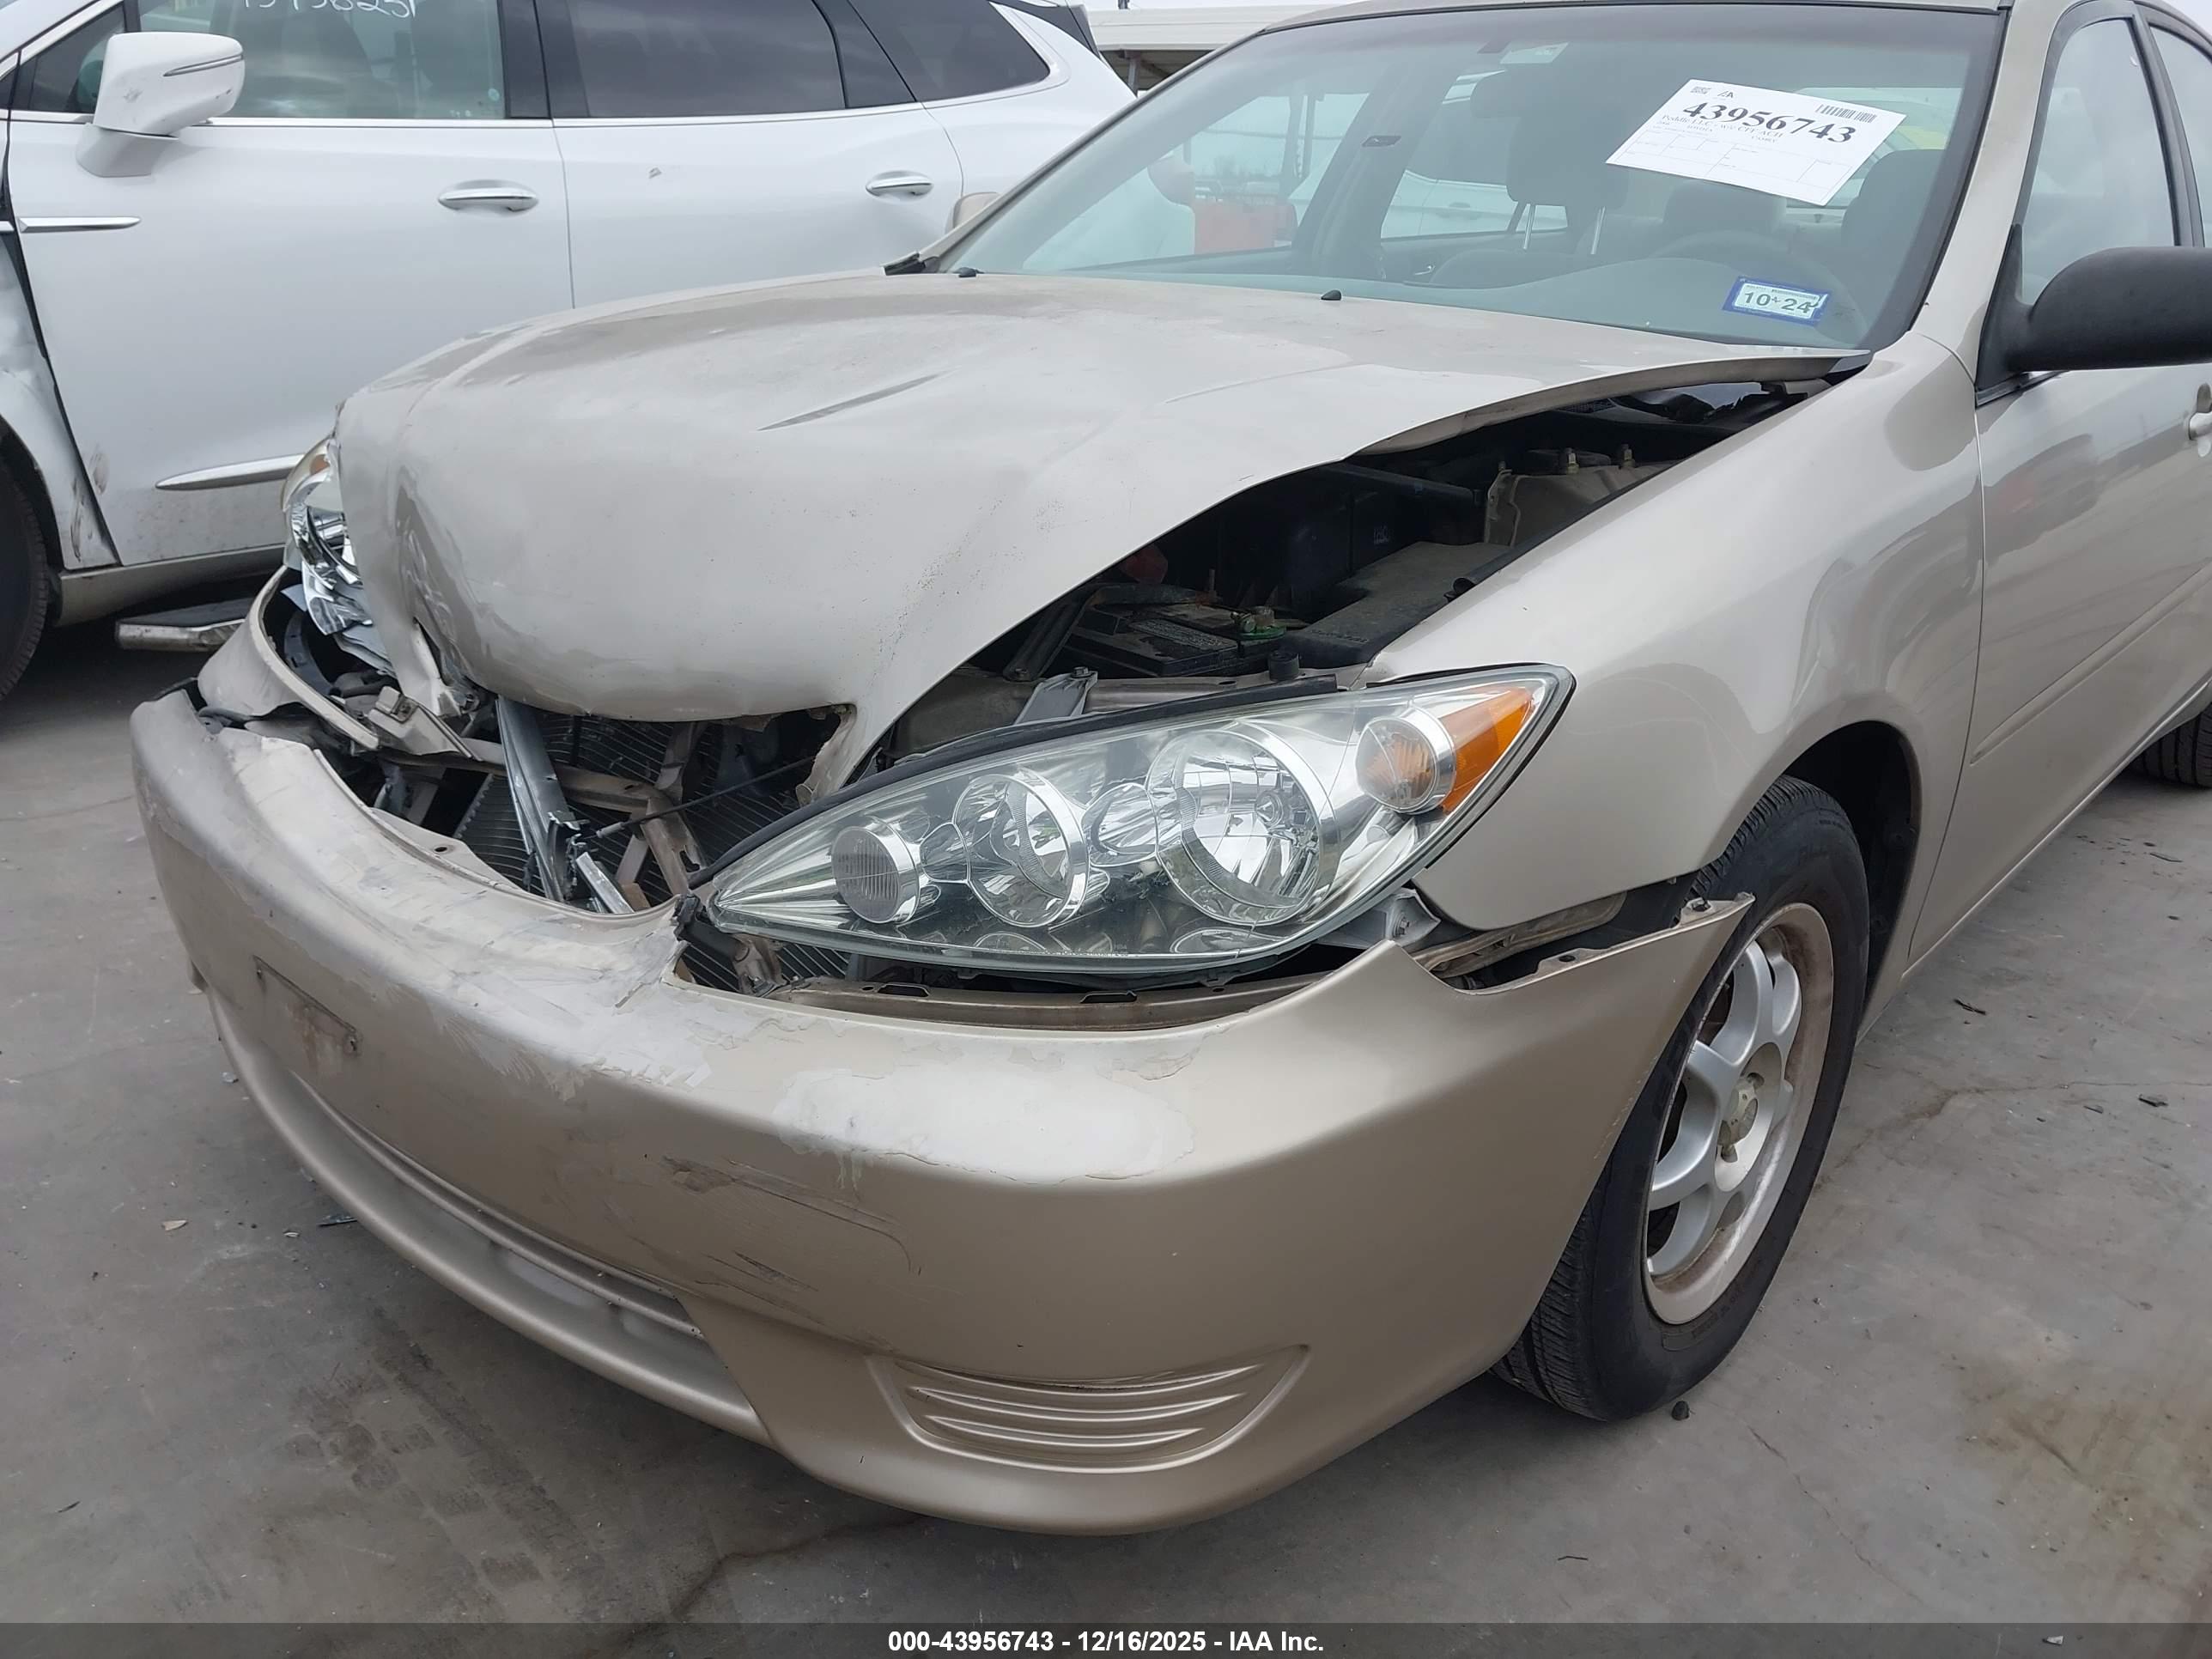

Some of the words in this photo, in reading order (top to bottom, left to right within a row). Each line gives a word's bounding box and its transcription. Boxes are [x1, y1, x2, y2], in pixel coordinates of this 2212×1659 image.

[1683, 102, 1856, 143] 43956743
[1744, 292, 1771, 306] 10
[1781, 298, 1816, 313] 24
